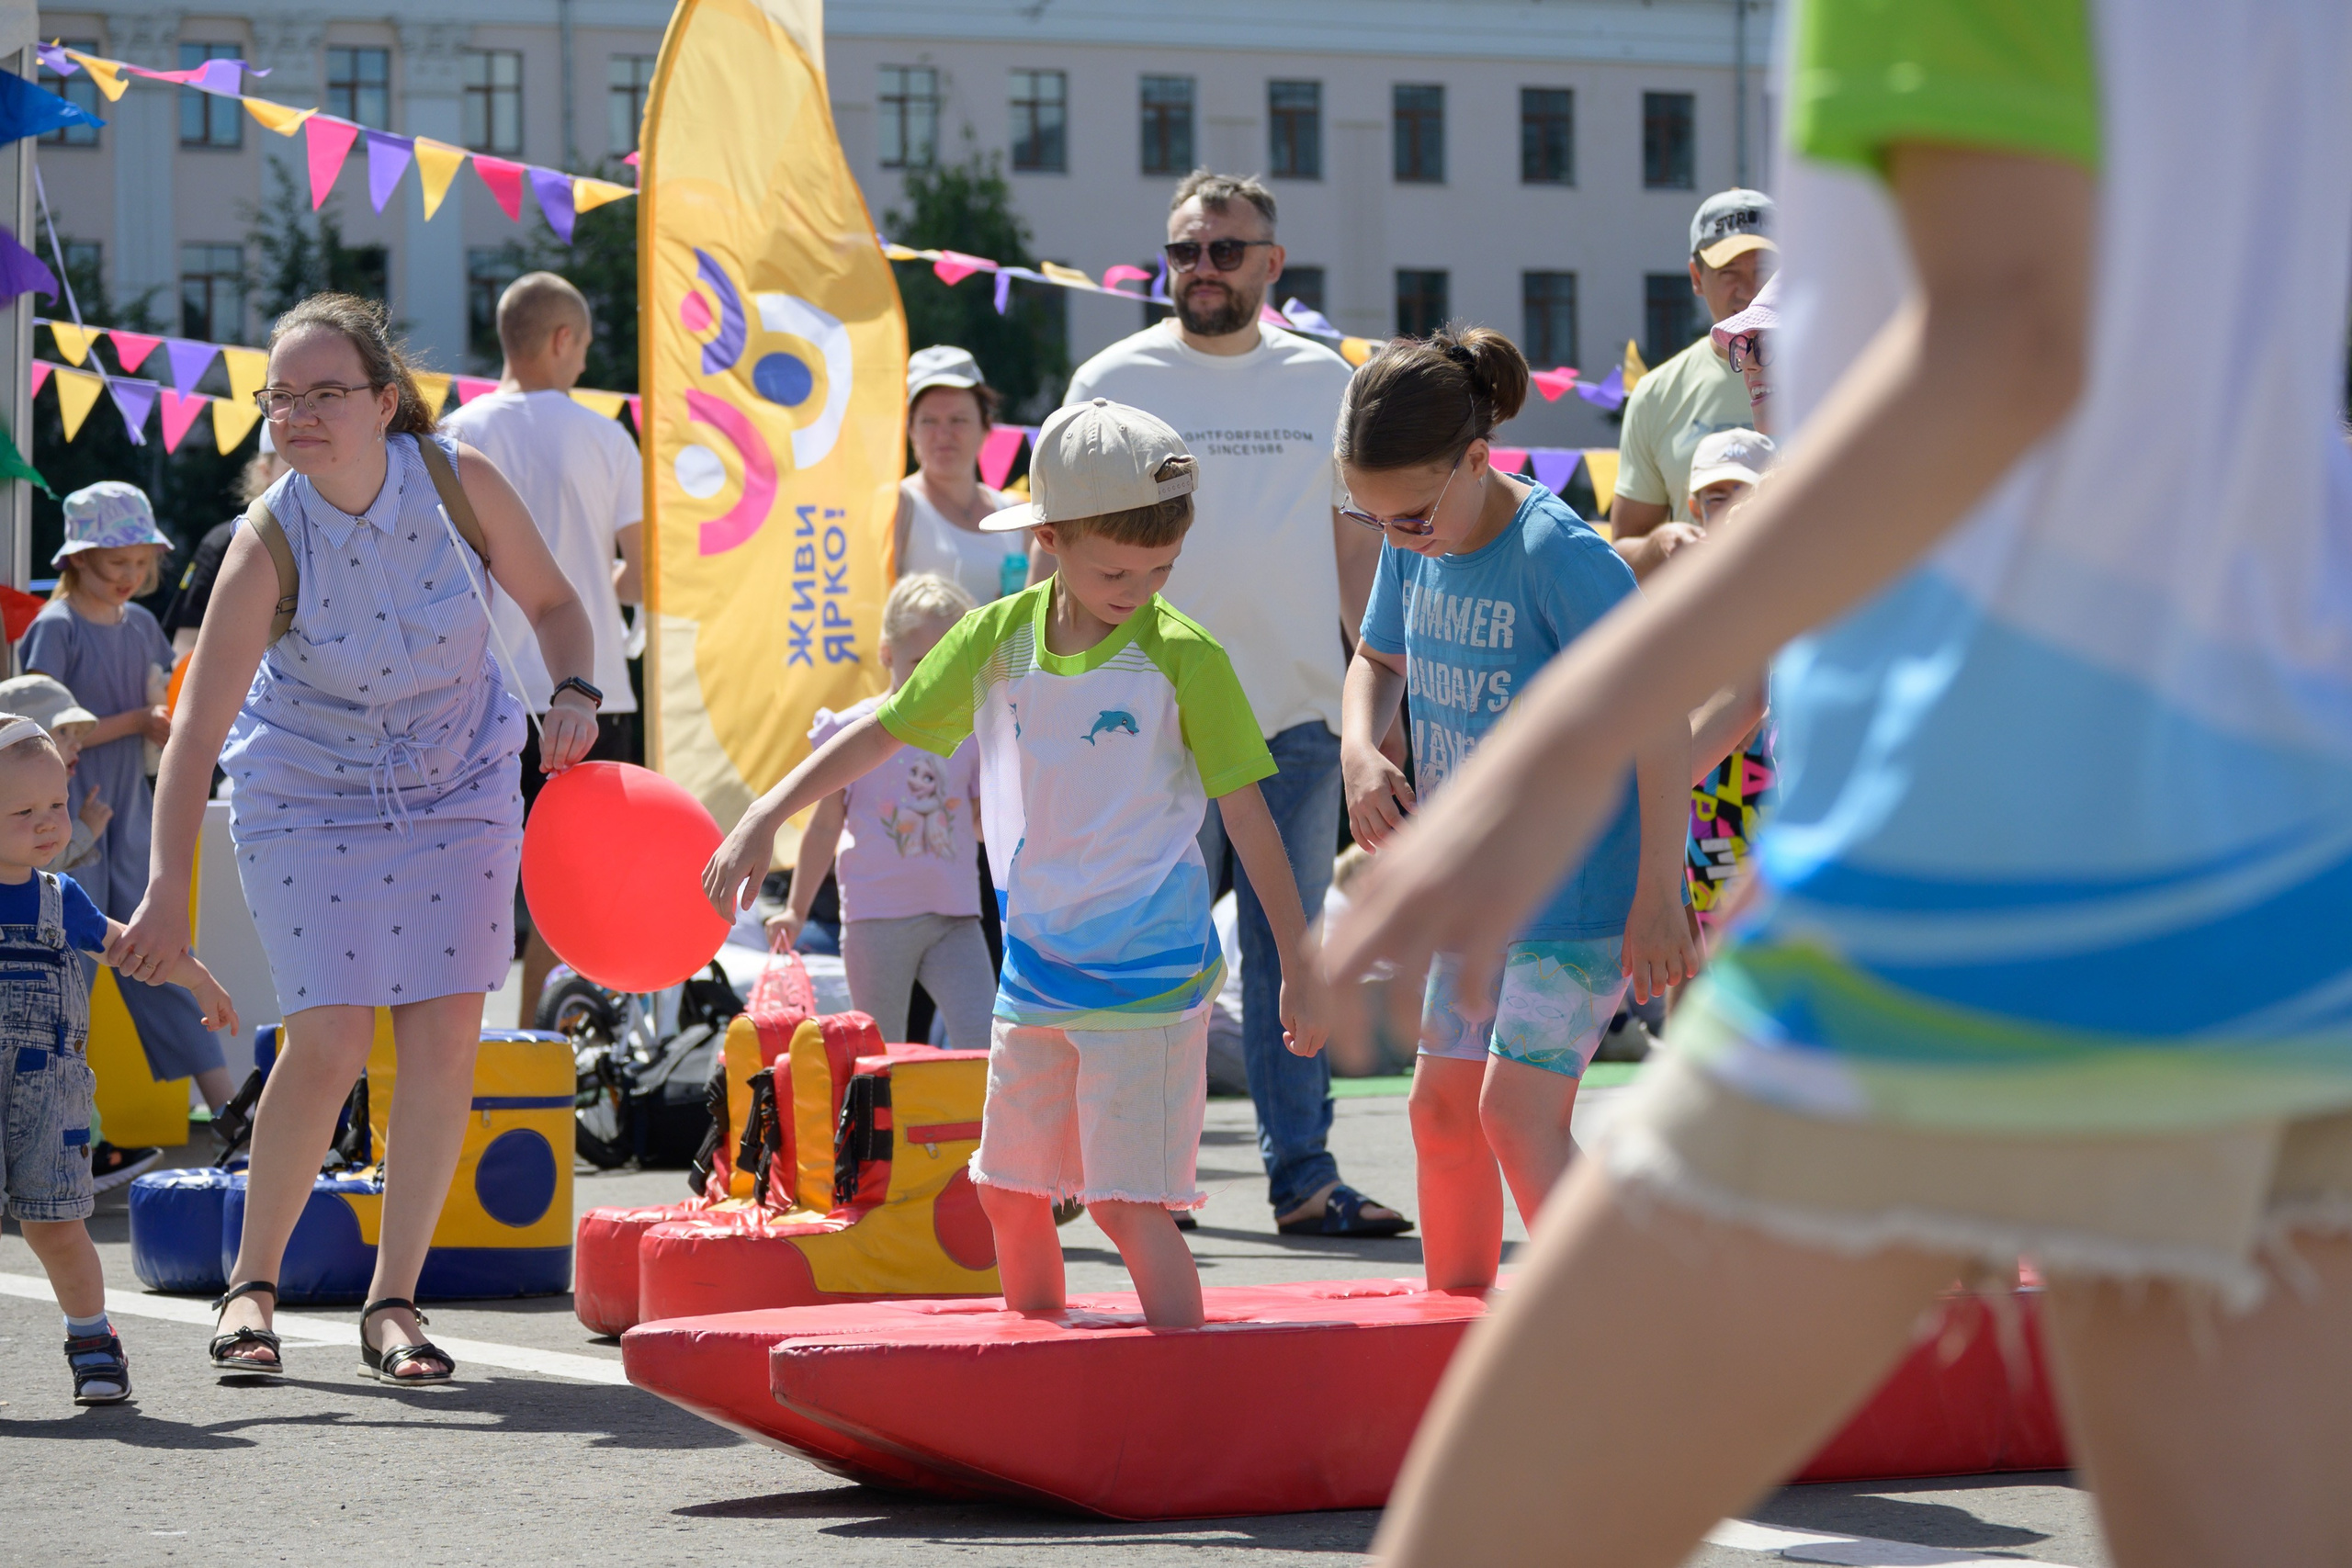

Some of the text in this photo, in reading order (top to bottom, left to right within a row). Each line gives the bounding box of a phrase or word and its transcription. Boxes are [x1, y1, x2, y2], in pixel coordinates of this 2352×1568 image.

[1182, 429, 1314, 443] GHTFORFREEDOM
[787, 504, 817, 668] ЖИВИ
[822, 509, 860, 664] ЯРКО!
[1409, 656, 1511, 713] OLIDAYS
